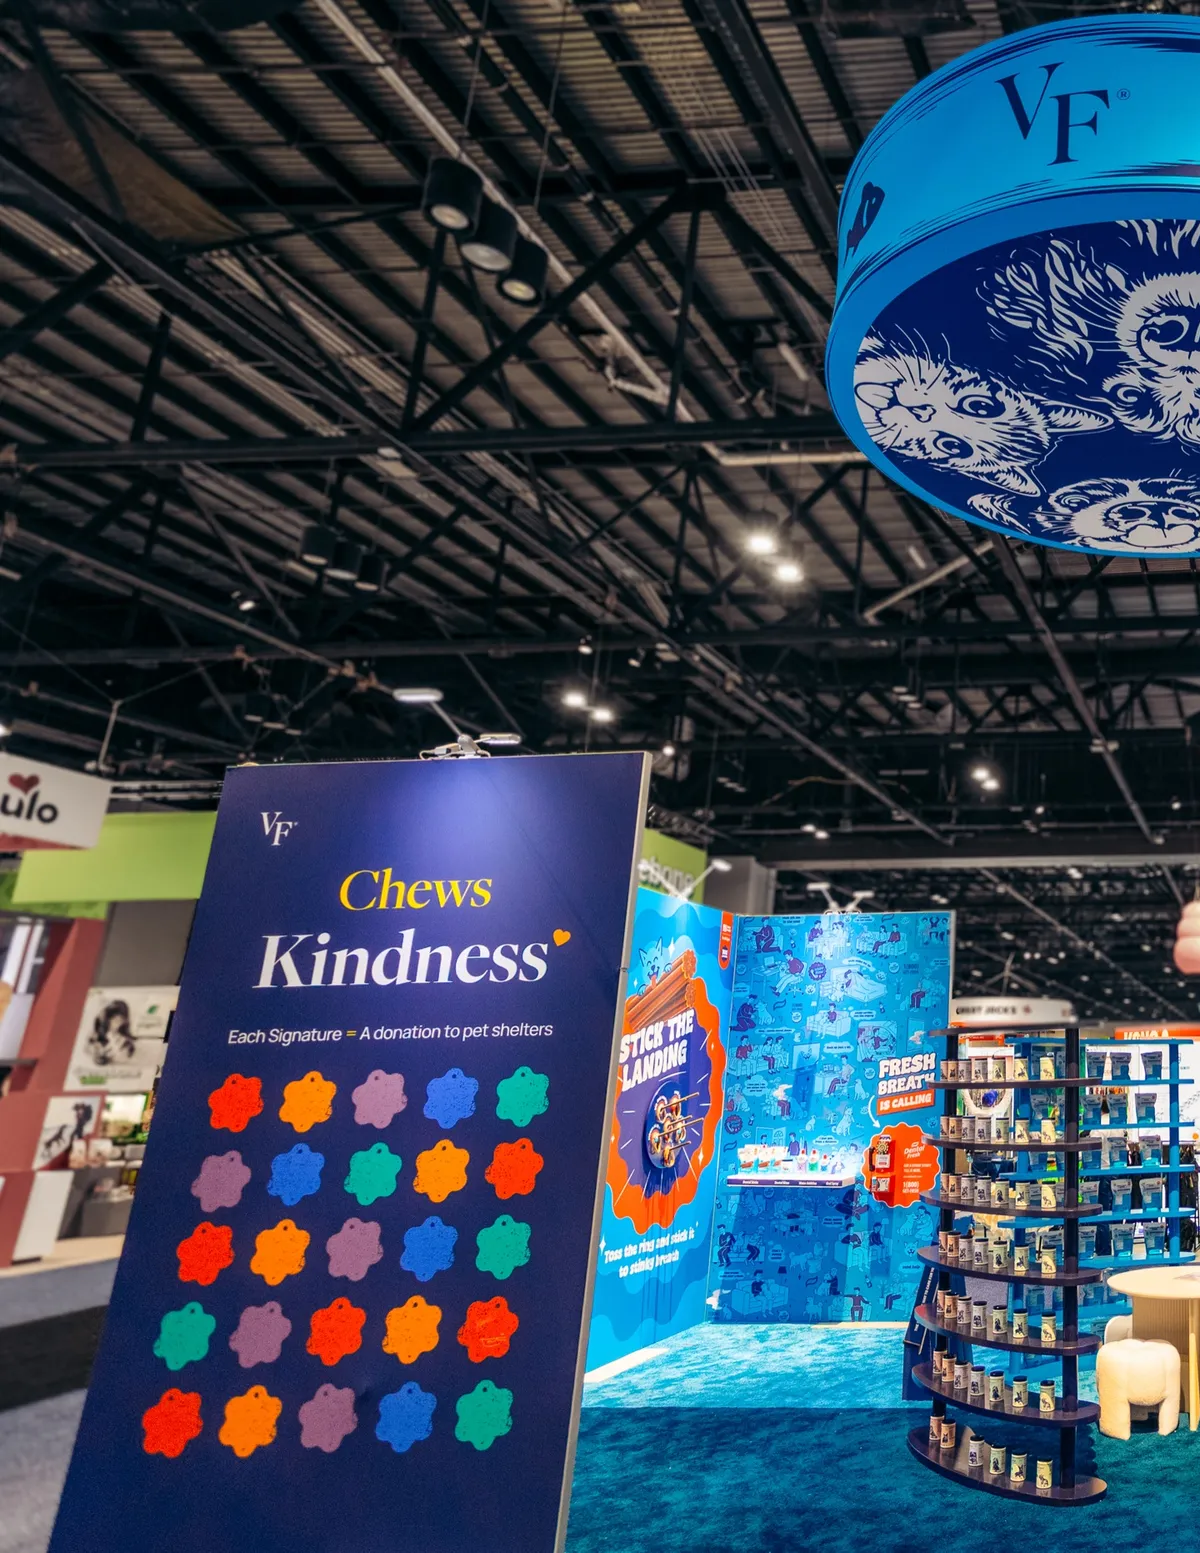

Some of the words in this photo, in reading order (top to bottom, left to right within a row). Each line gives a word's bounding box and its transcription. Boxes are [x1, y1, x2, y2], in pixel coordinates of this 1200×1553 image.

[339, 867, 493, 911] Chews
[252, 928, 549, 989] Kindness
[228, 1029, 265, 1044] Each
[268, 1027, 342, 1046] Signature
[360, 1026, 372, 1040] A
[374, 1024, 441, 1040] donation
[444, 1025, 460, 1038] to
[462, 1025, 489, 1042] pet
[492, 1021, 553, 1037] shelters
[619, 1021, 665, 1064] STICK
[667, 1008, 695, 1042] THE
[621, 1039, 688, 1092] LANDING
[878, 1052, 936, 1079] FRESH
[878, 1072, 935, 1095] BREATH
[879, 1100, 891, 1111] IS
[891, 1093, 932, 1108] CALLING
[604, 1248, 622, 1264] Toss
[624, 1243, 637, 1258] the
[638, 1238, 655, 1254] ring
[656, 1233, 670, 1249] and
[670, 1229, 687, 1244] stick
[688, 1226, 695, 1240] it
[619, 1265, 629, 1278] to
[629, 1256, 655, 1275] stinky
[655, 1248, 679, 1267] breath
